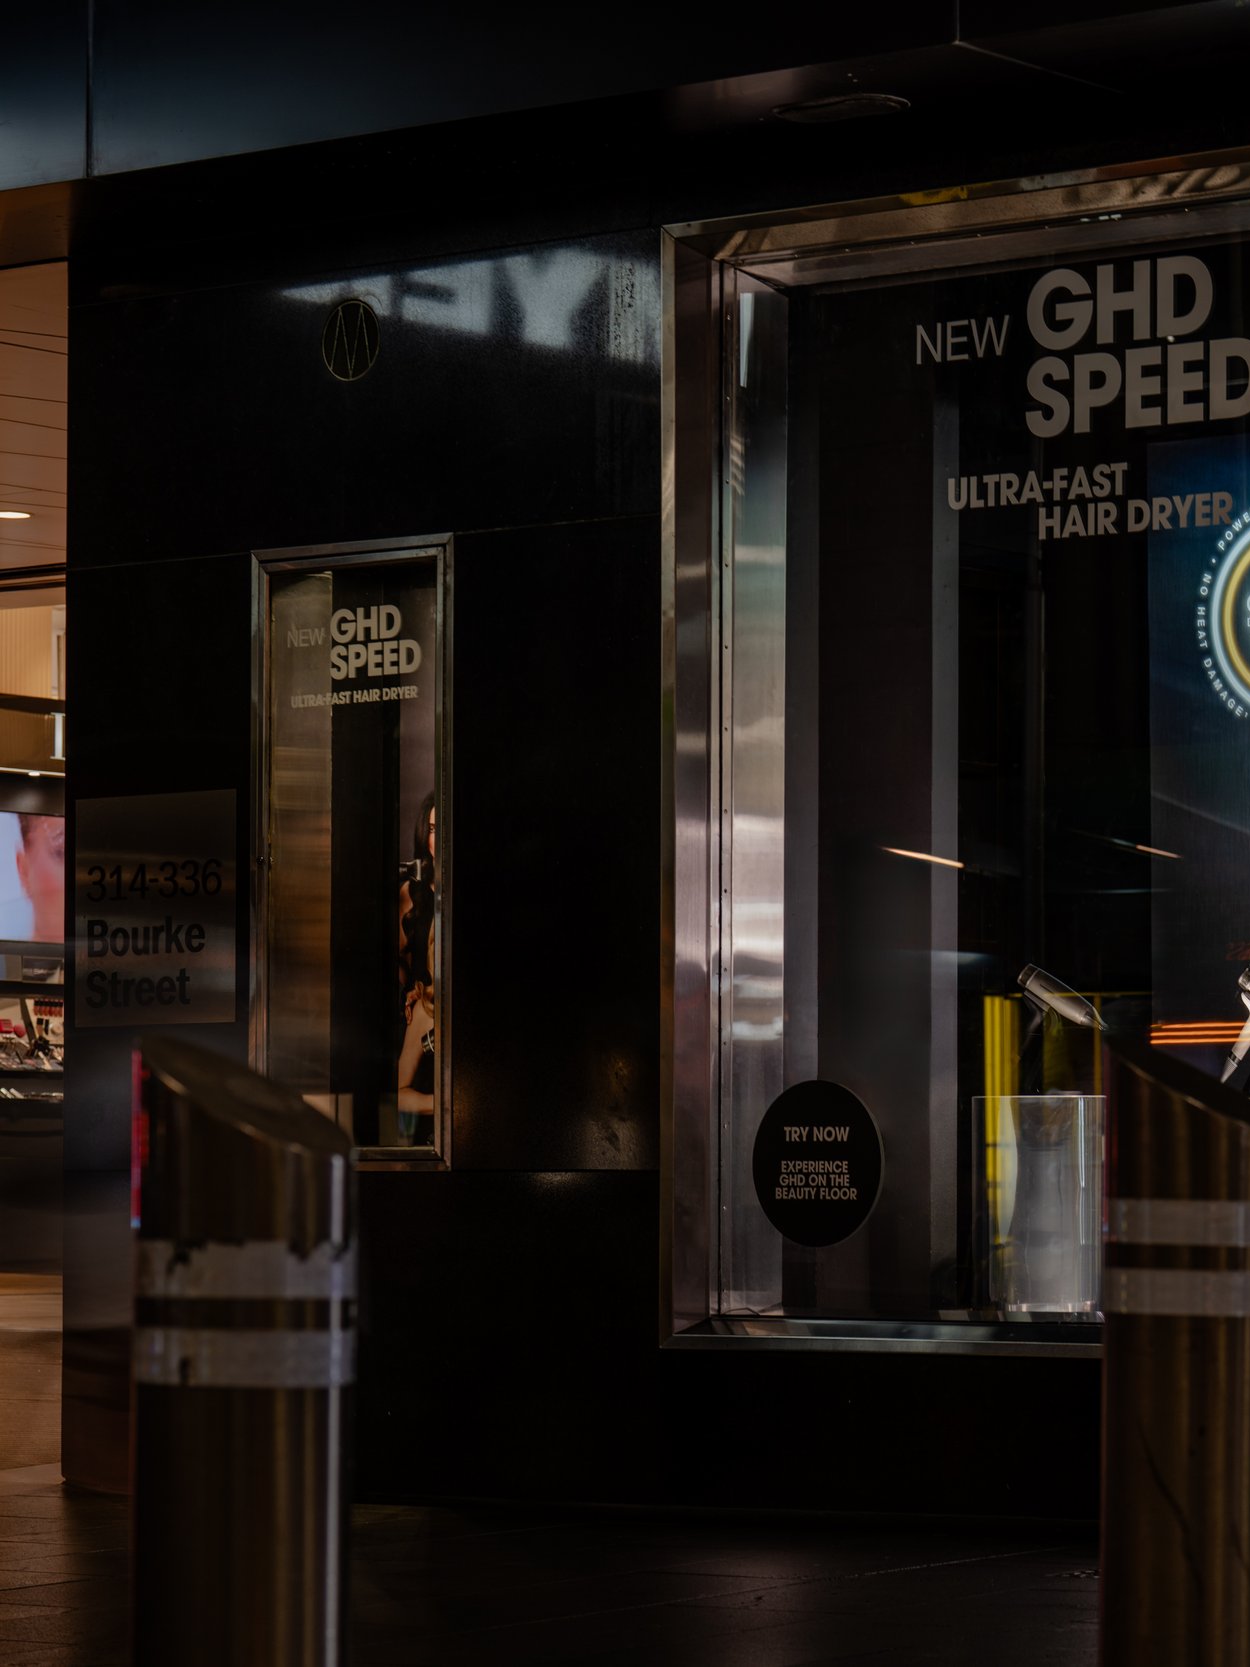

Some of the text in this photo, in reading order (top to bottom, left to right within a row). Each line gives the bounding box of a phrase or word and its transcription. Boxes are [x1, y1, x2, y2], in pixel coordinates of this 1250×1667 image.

[1026, 255, 1214, 350] GHD
[914, 314, 1010, 366] NEW
[947, 462, 1129, 511] ULTRA-FAST
[1038, 491, 1234, 540] HAIR DRYER
[1199, 573, 1212, 595] NO
[287, 628, 325, 649] NEW
[330, 604, 403, 644] GHD
[1197, 606, 1209, 649] HEAT
[330, 639, 422, 680] SPEED
[290, 685, 418, 709] ULTRA-FAST HAIR DRYER
[86, 858, 222, 902] 314-336
[87, 915, 205, 957] Bourke
[86, 968, 191, 1008] Street
[784, 1125, 850, 1142] TRY NOW
[779, 1173, 850, 1187] GHD ON THE
[780, 1160, 849, 1173] EXPERIENCE
[775, 1187, 858, 1200] BEAUTY FLOOR
